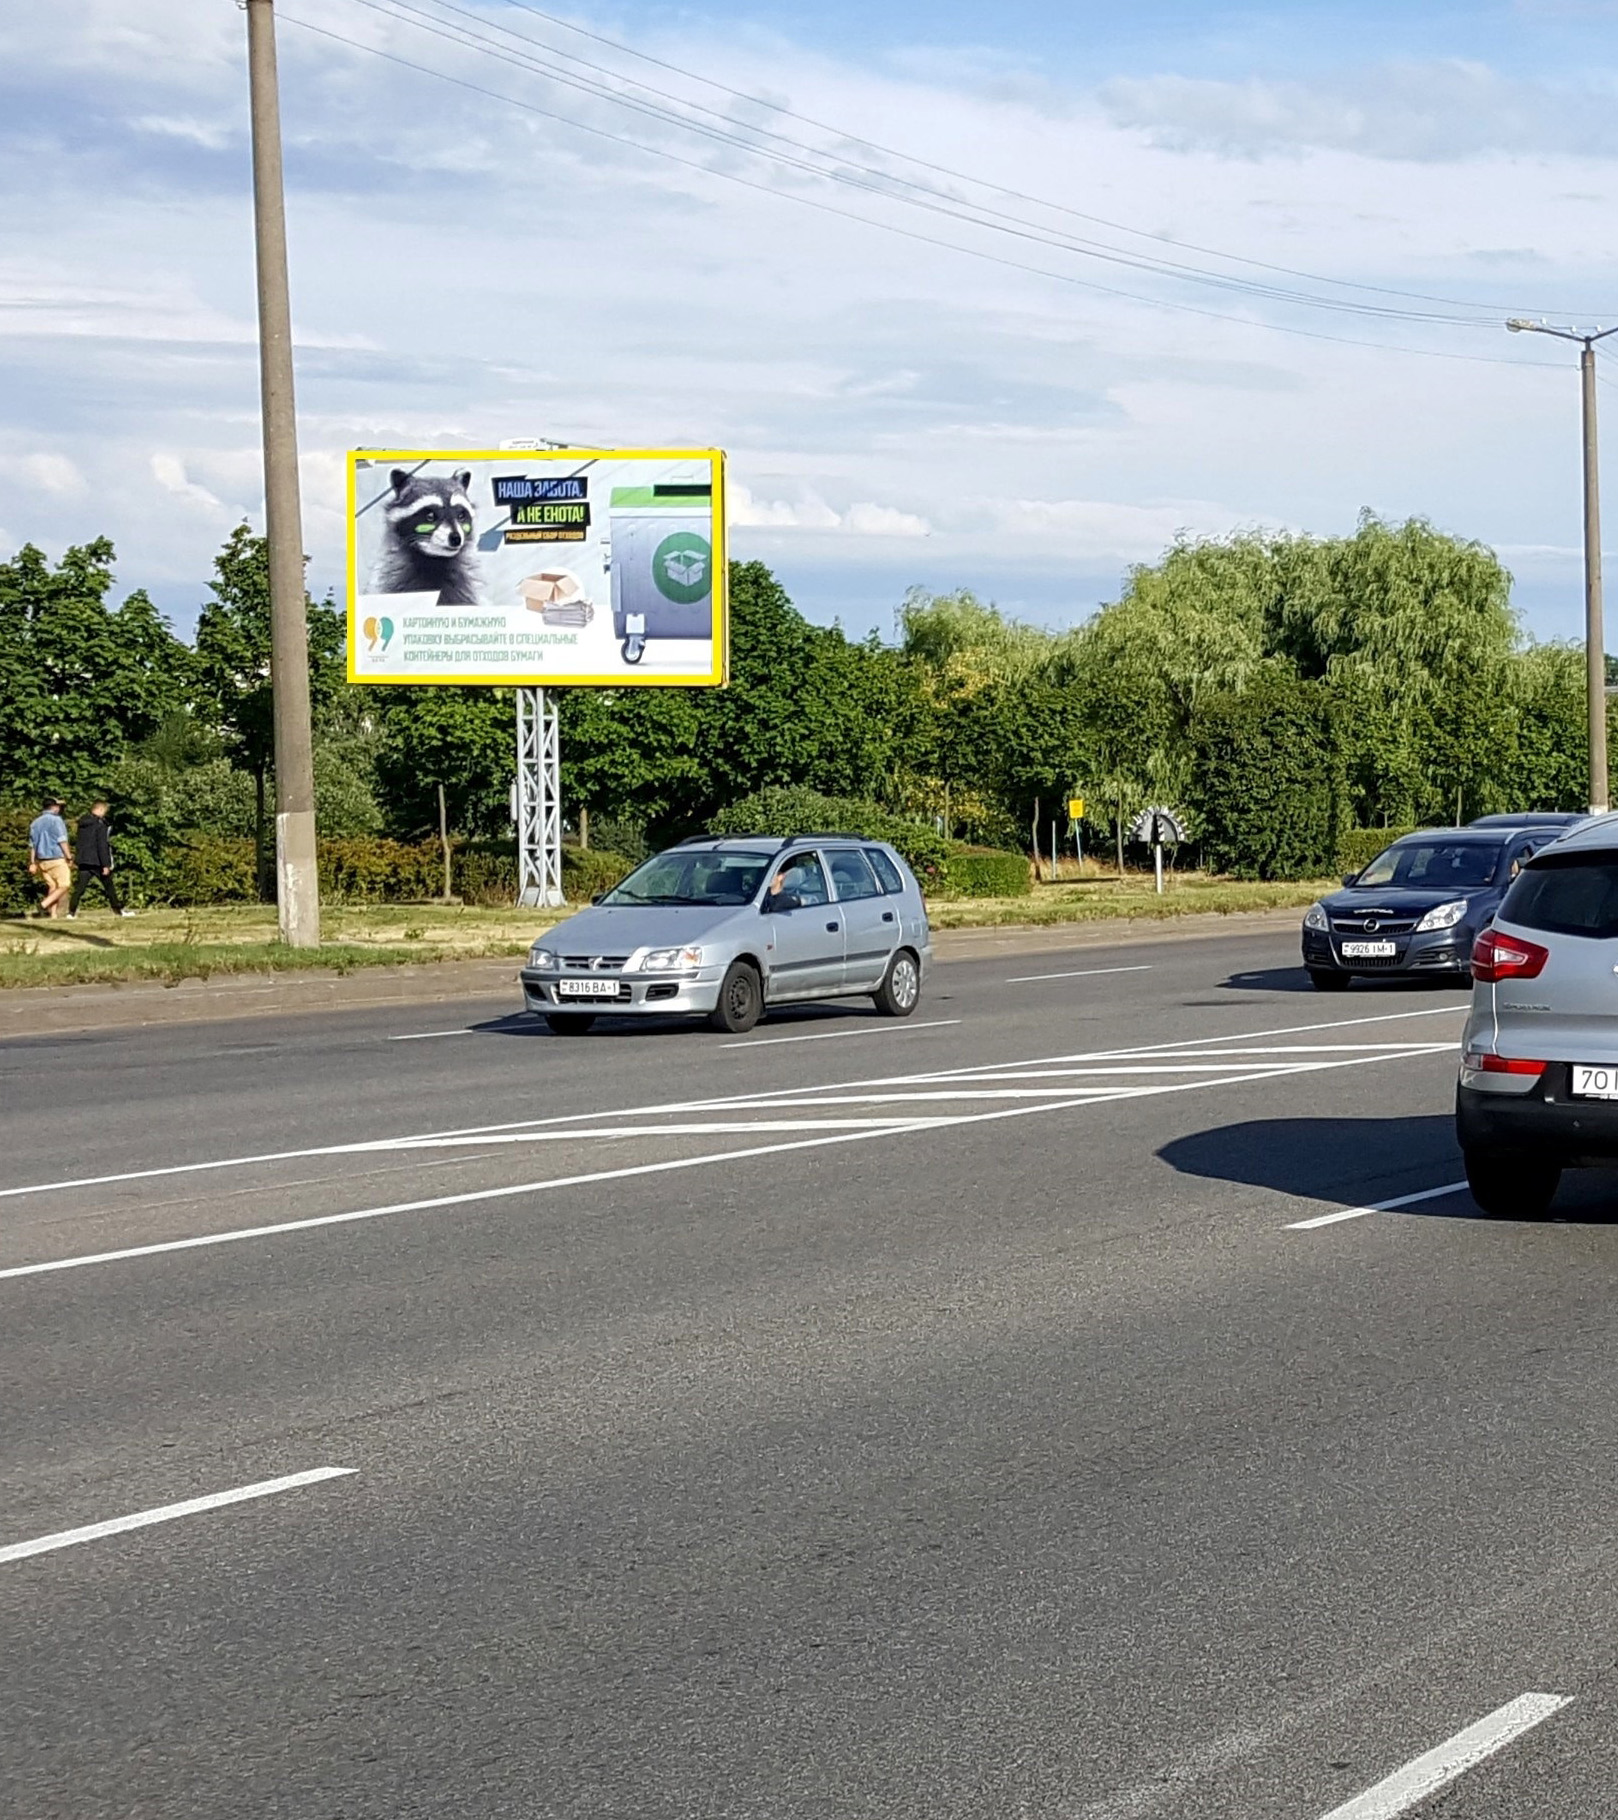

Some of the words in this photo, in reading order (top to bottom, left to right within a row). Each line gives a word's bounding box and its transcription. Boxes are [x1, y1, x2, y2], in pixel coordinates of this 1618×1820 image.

[498, 481, 532, 498] НАША
[517, 506, 525, 523] А
[527, 506, 542, 523] НЕ
[544, 505, 584, 523] ЕНОТА!
[458, 617, 506, 628] БУМАЖНУЮ
[511, 650, 543, 662] БУМАГИ
[569, 981, 590, 993] 8316
